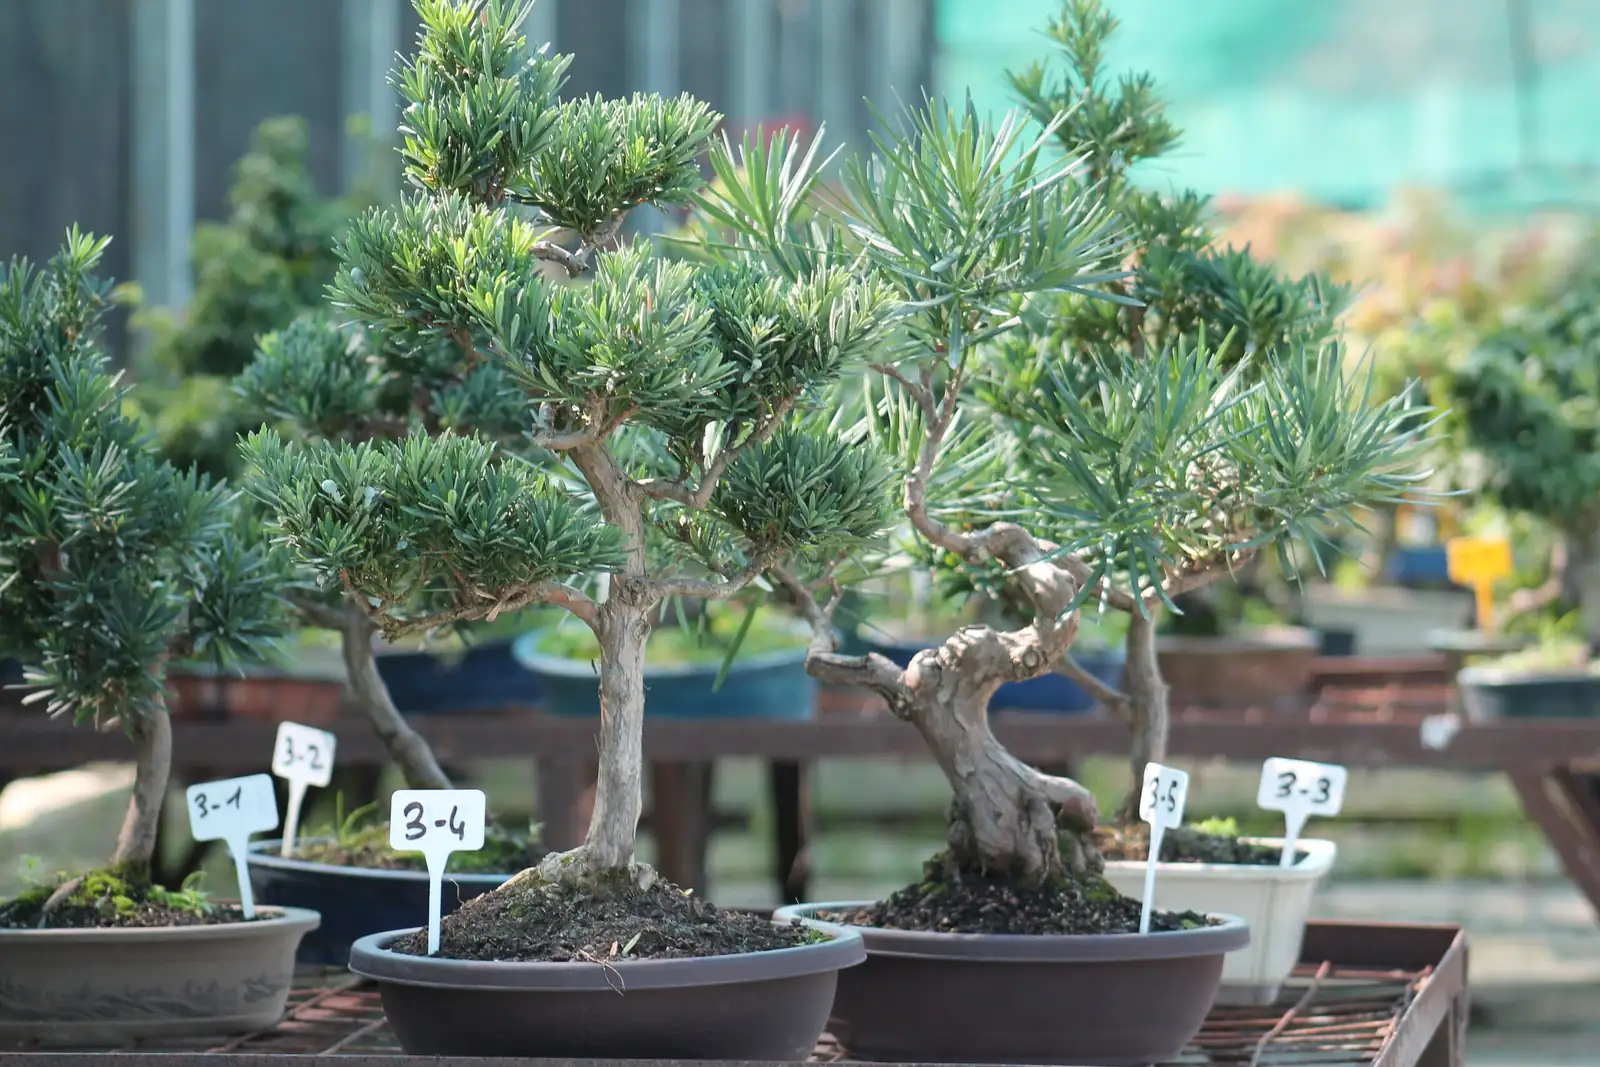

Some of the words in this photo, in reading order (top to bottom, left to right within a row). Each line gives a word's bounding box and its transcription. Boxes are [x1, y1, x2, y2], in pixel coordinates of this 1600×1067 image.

[283, 736, 325, 769] 3-2
[194, 786, 242, 818] 3-1
[1276, 772, 1330, 803] 3-3
[403, 801, 465, 840] 3-4
